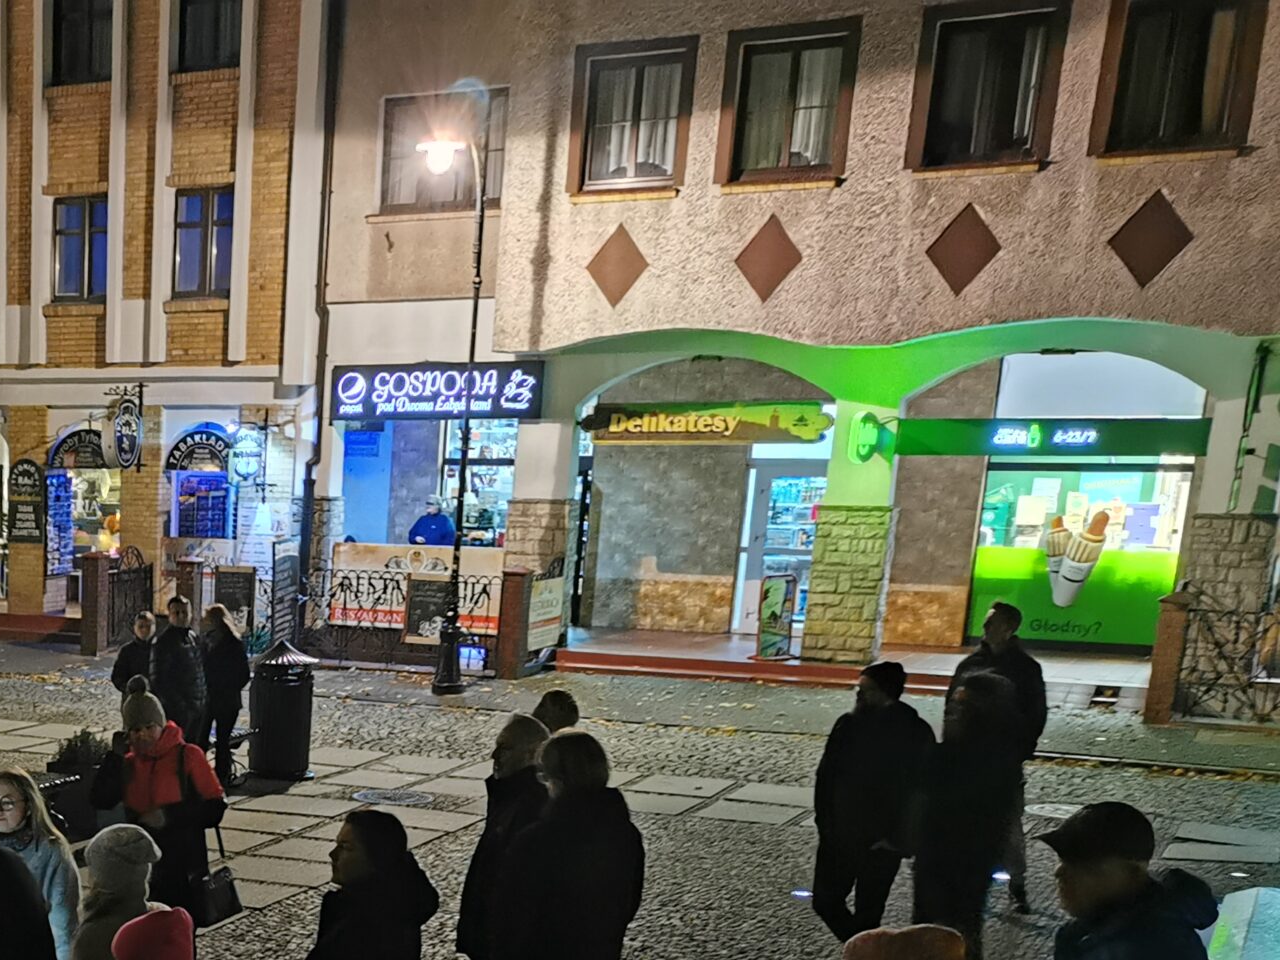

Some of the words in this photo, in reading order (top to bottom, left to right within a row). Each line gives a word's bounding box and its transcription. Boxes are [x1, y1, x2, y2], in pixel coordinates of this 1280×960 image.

[376, 399, 395, 414] pod
[396, 397, 434, 412] Dwoma
[435, 396, 492, 415] Łabędiami
[609, 413, 741, 437] Delikatesy
[53, 436, 79, 467] Wyroby
[1029, 618, 1102, 637] Głodny?
